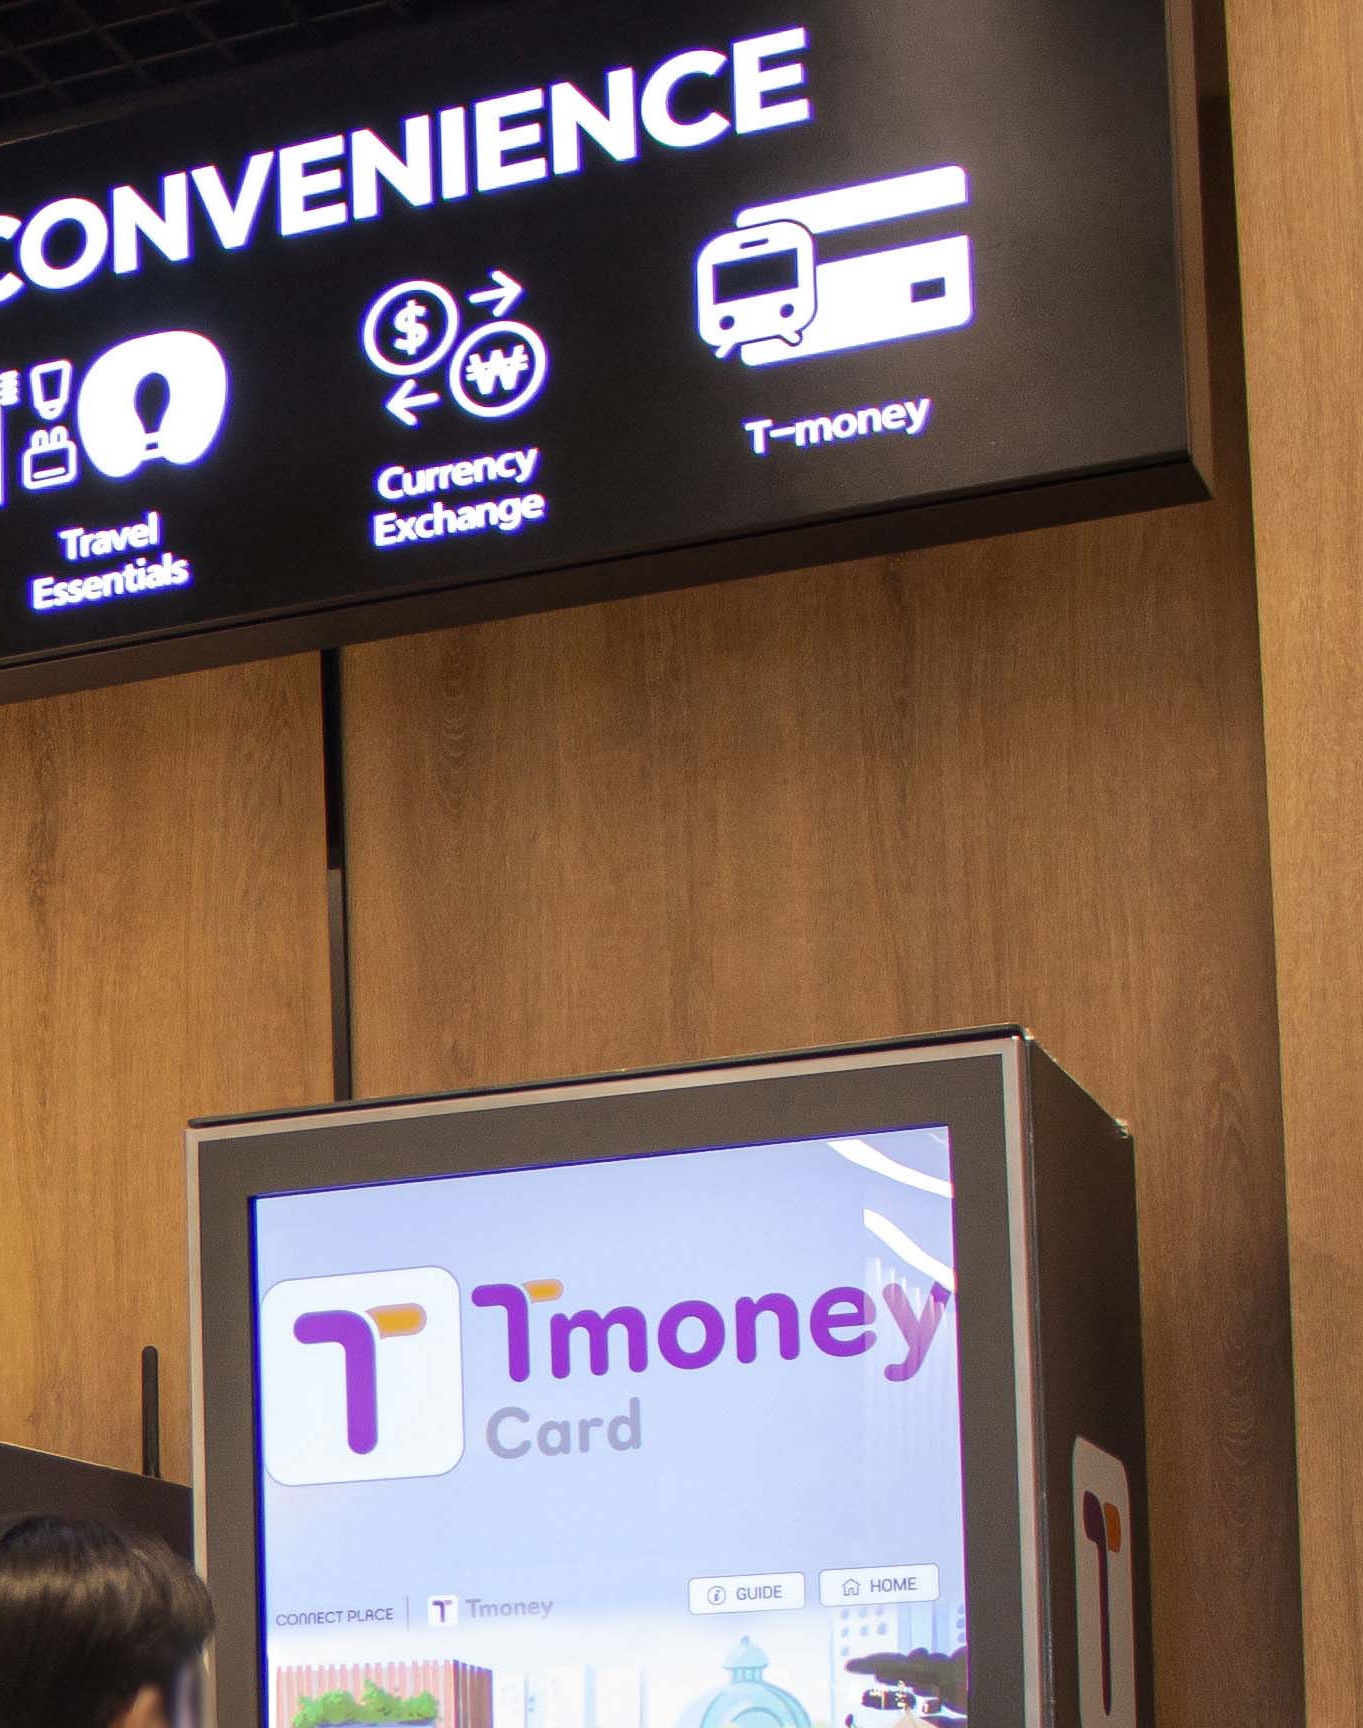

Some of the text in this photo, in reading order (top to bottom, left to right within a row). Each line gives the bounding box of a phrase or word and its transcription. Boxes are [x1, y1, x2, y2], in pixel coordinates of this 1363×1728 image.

[745, 397, 931, 455] T-money
[376, 445, 538, 503] Currency
[59, 512, 160, 563] Travel
[373, 489, 545, 548] Exchange
[31, 553, 189, 613] Essentials
[471, 1277, 953, 1384] Tmoney
[485, 1397, 643, 1461] Card
[465, 1596, 554, 1624] Tmoney
[735, 1582, 783, 1604] GUIDE
[869, 1575, 918, 1595] HOME
[347, 1605, 395, 1625] PLACE
